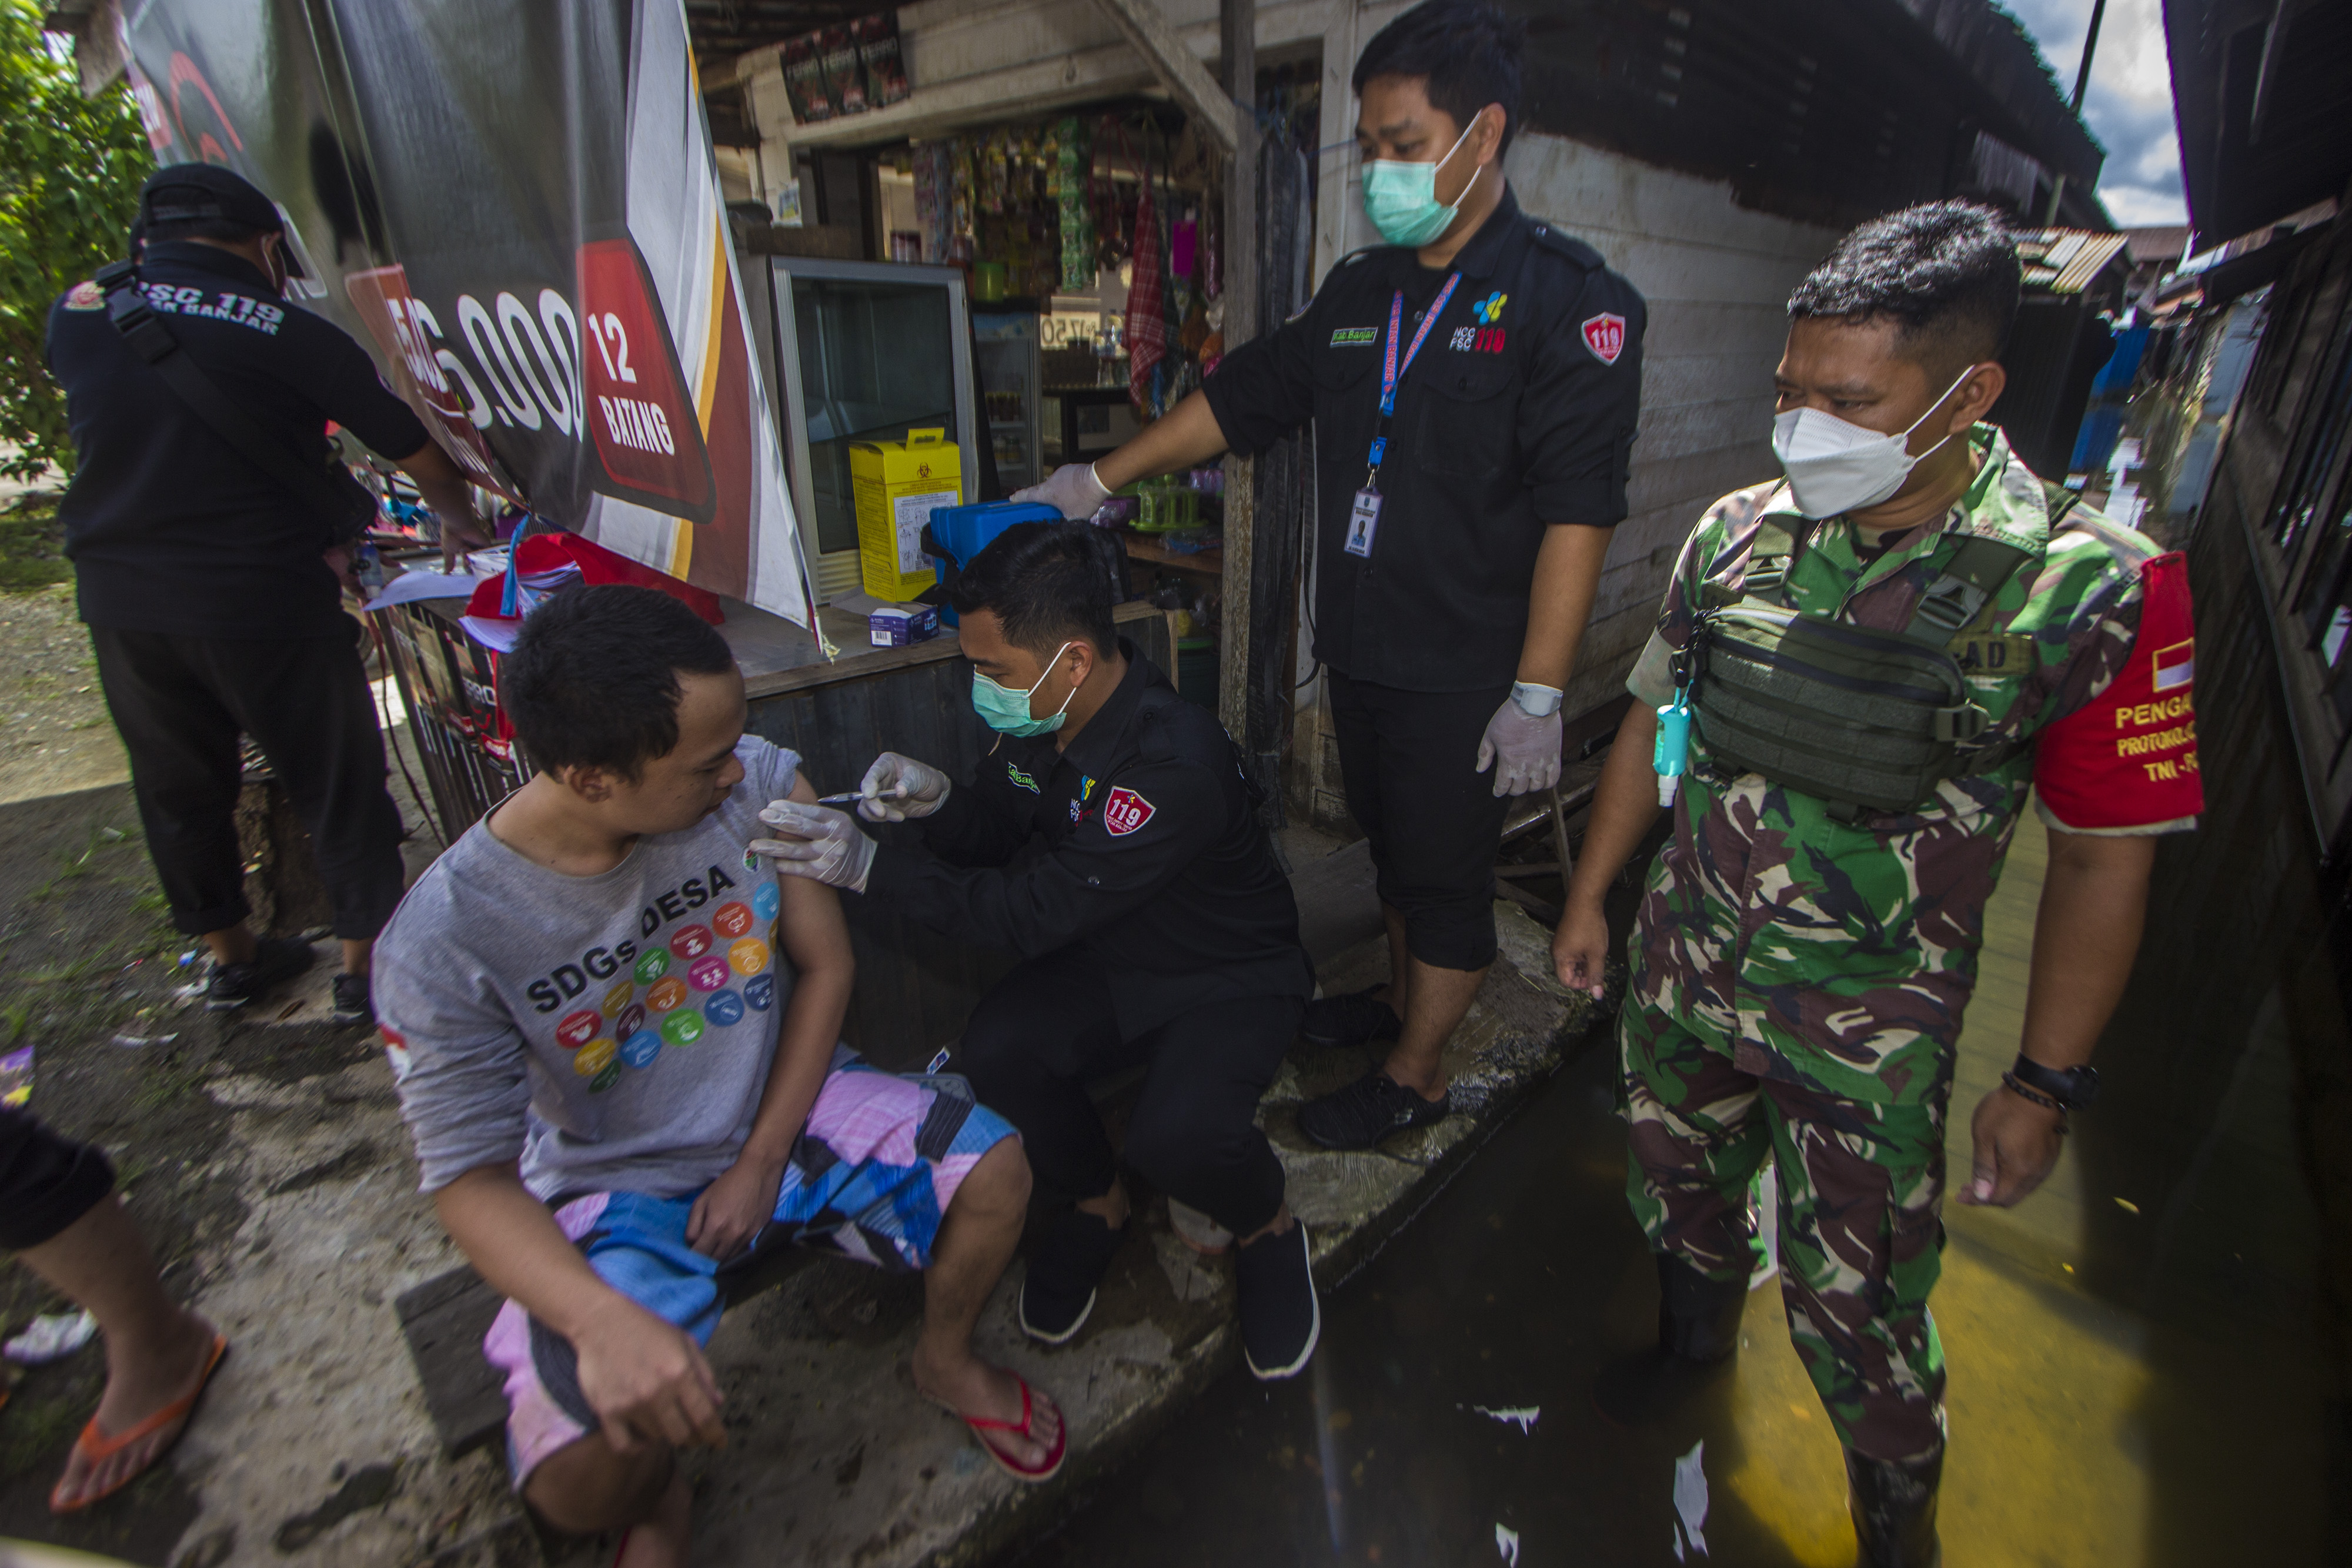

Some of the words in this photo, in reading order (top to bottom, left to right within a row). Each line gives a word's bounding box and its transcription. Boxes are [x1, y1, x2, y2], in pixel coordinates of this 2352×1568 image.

[181, 302, 279, 336] BANJAR
[218, 293, 285, 324] 119
[1348, 329, 1375, 342] Banjar
[1388, 317, 1400, 345] INTAN
[1449, 337, 1472, 352] PSC
[1453, 326, 1476, 340] NCC
[1591, 326, 1620, 350] 119
[587, 312, 637, 384] 12
[1384, 345, 1397, 382] BANJAR
[598, 394, 675, 457] BATANG
[2117, 727, 2189, 758] PROTOKOL
[2143, 759, 2181, 783] TNI
[1109, 798, 1141, 827] 119
[527, 939, 637, 1013] SDGs
[640, 865, 736, 940] DESA
